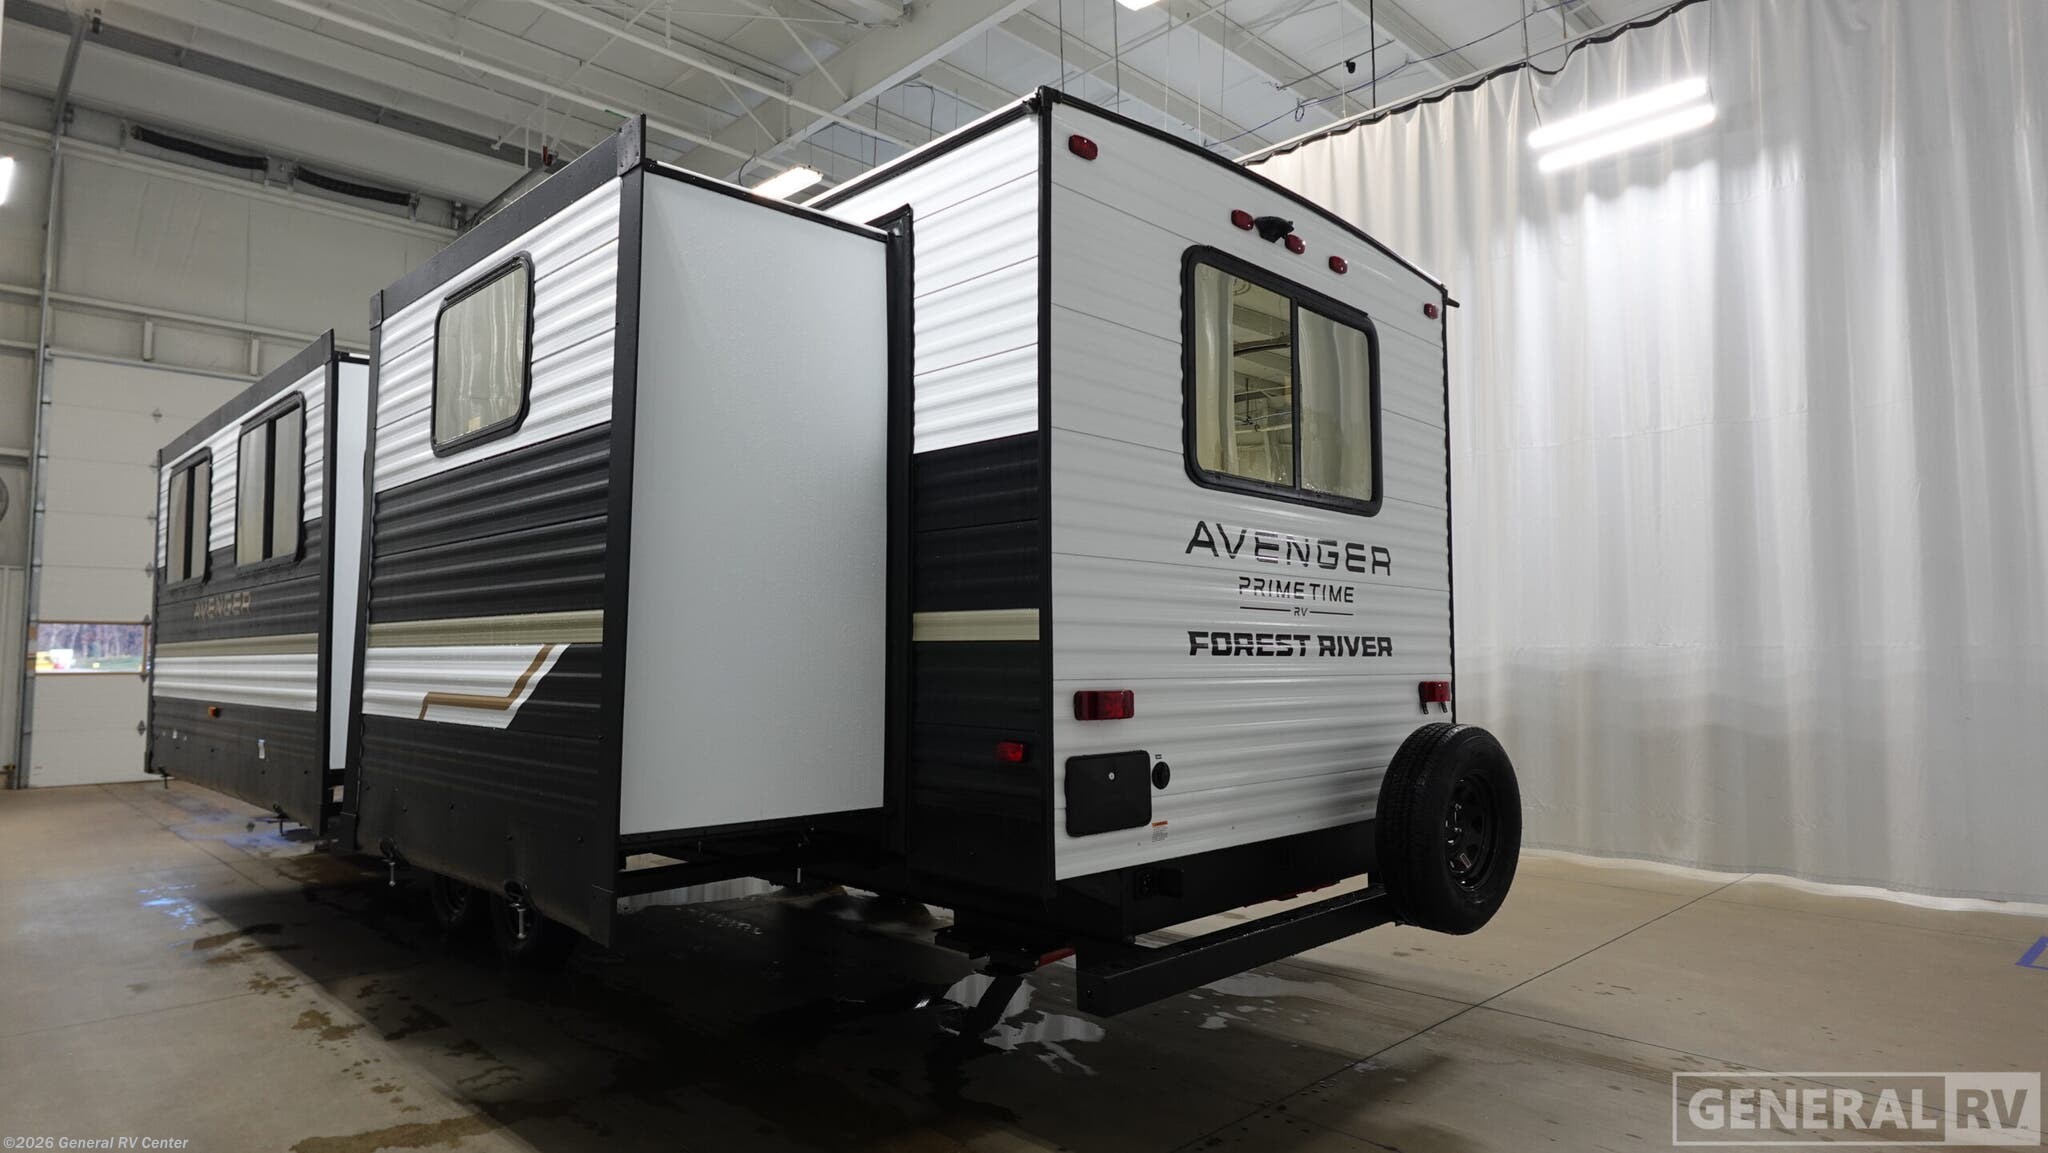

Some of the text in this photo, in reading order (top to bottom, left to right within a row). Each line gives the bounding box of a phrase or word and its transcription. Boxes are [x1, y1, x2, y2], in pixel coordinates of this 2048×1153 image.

[1185, 520, 1391, 576] AVENGER
[192, 591, 252, 624] AVENGER
[1294, 606, 1309, 617] RV
[1187, 631, 1393, 657] FOREST RIVER
